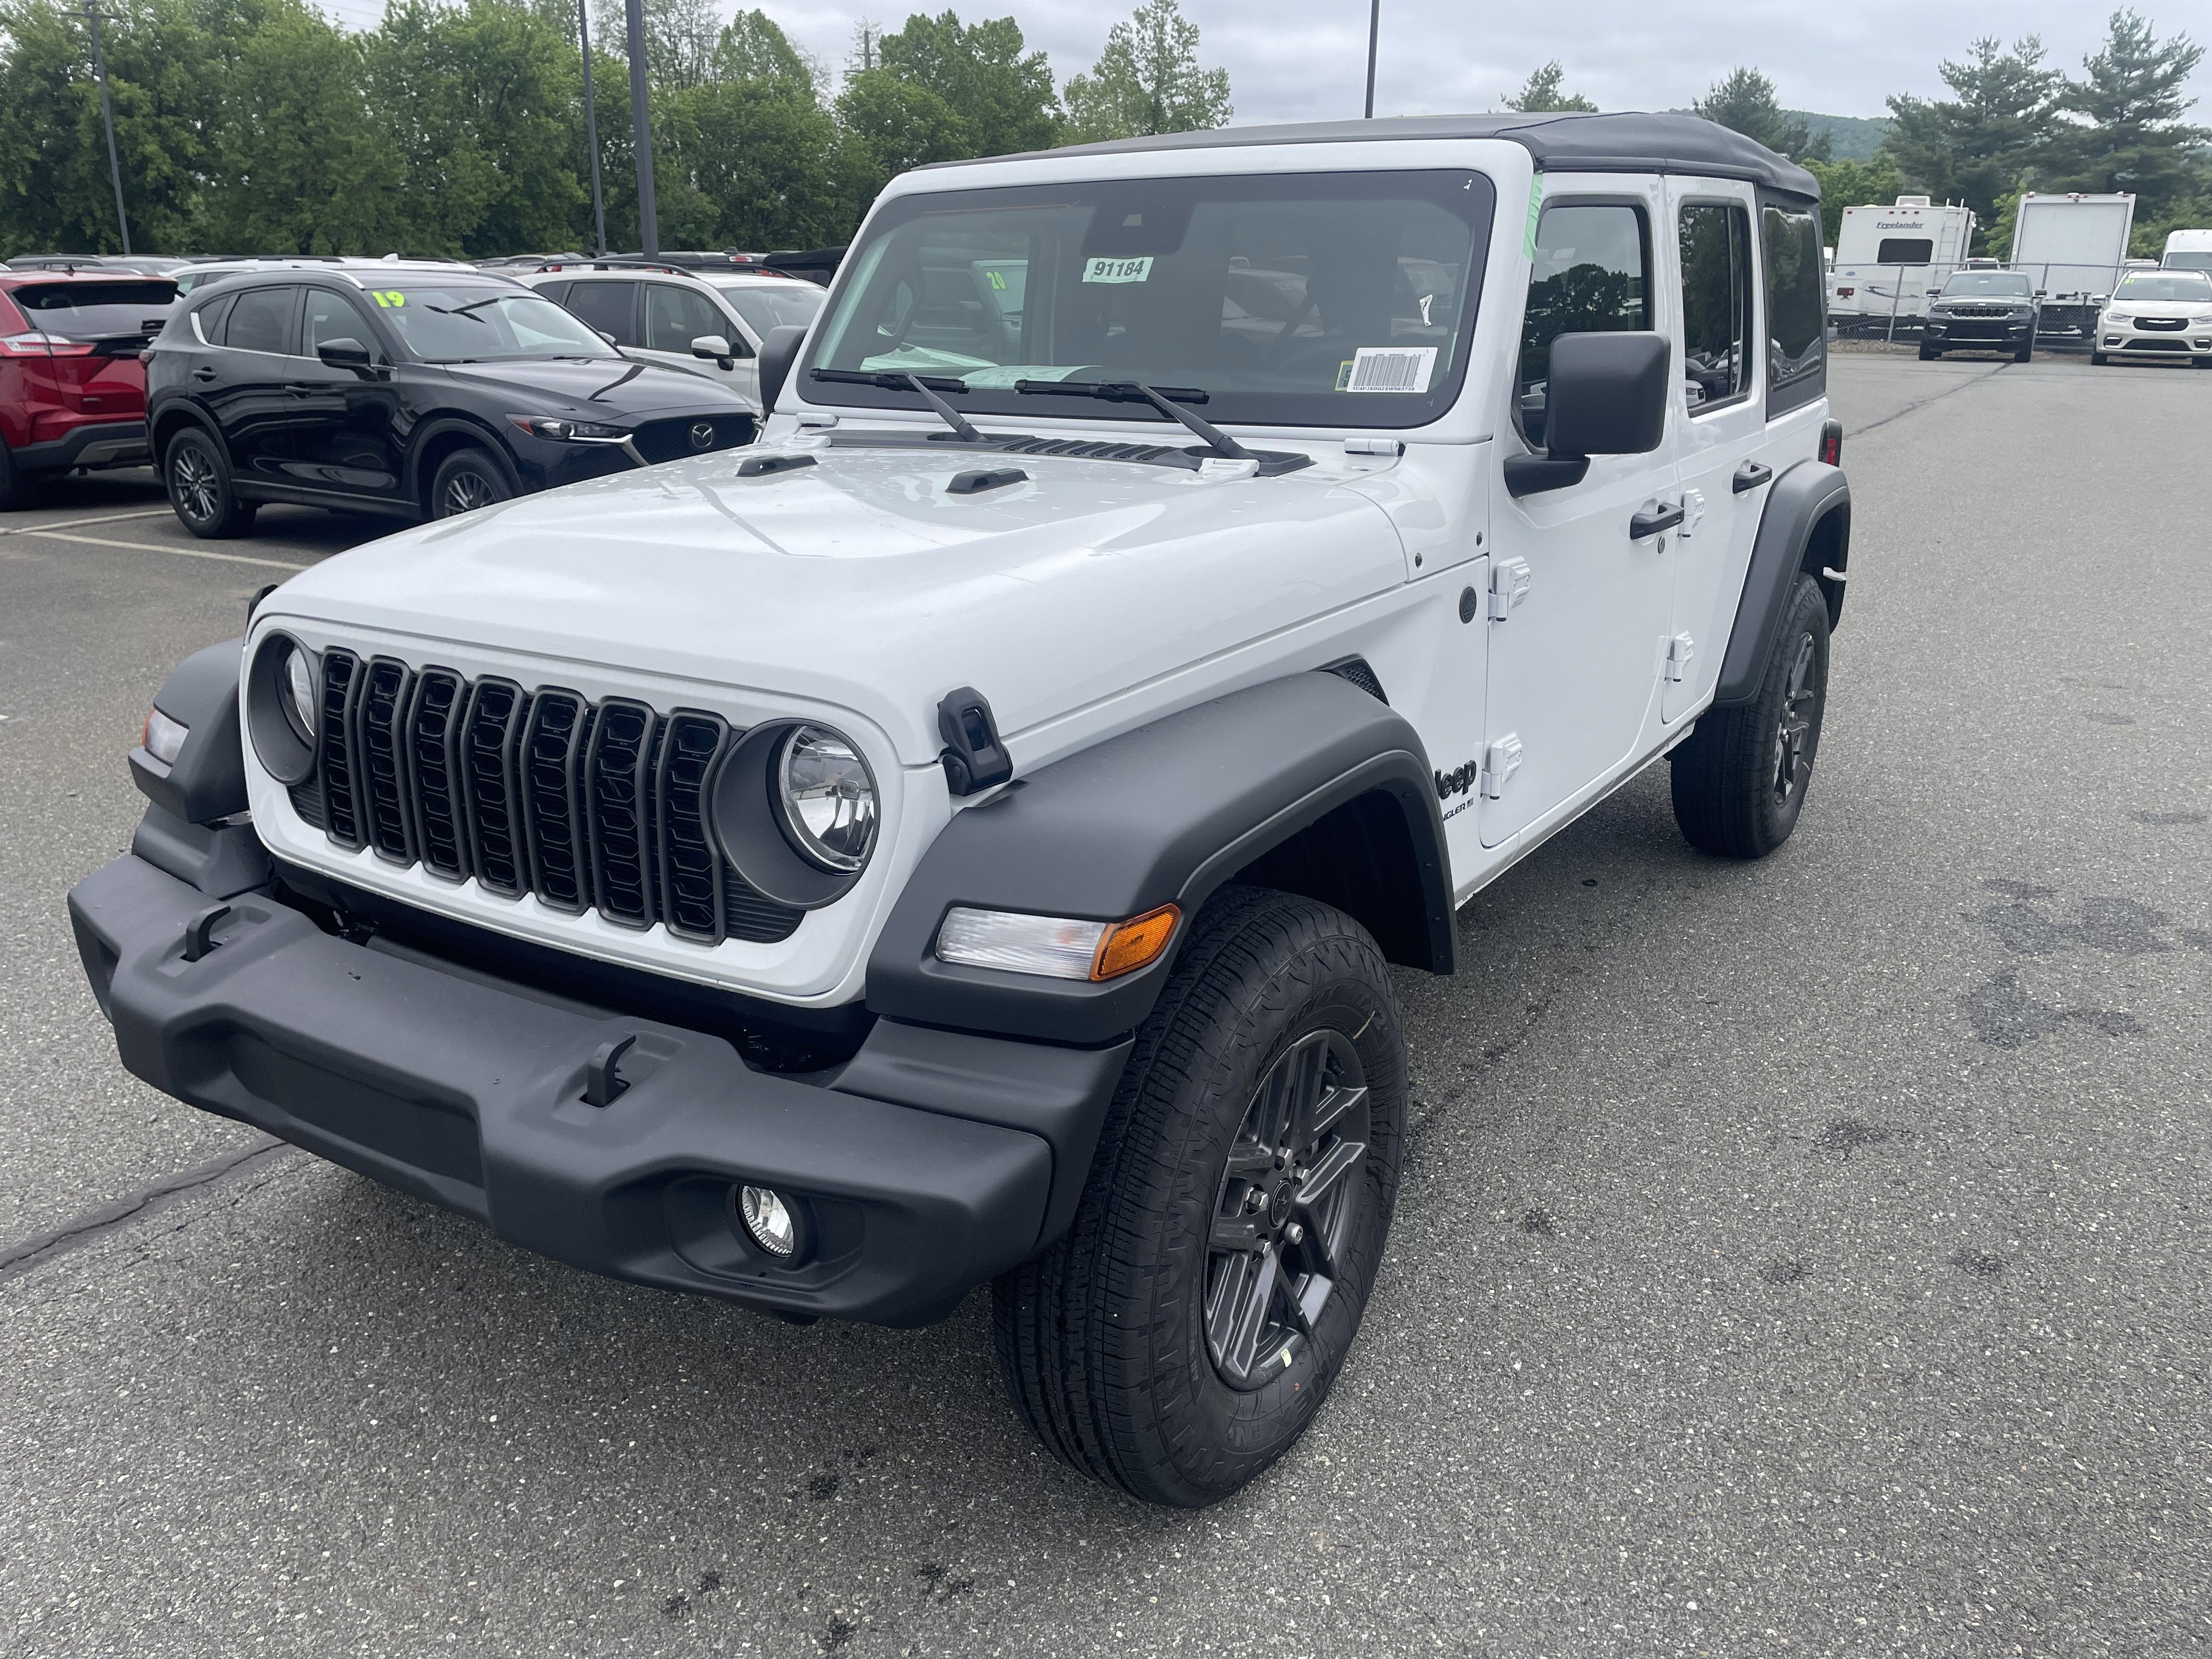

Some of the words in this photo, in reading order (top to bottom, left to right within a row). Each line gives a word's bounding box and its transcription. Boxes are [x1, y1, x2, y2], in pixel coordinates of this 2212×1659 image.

[1093, 260, 1145, 277] 91184
[985, 271, 1007, 290] 20
[371, 290, 405, 308] 19
